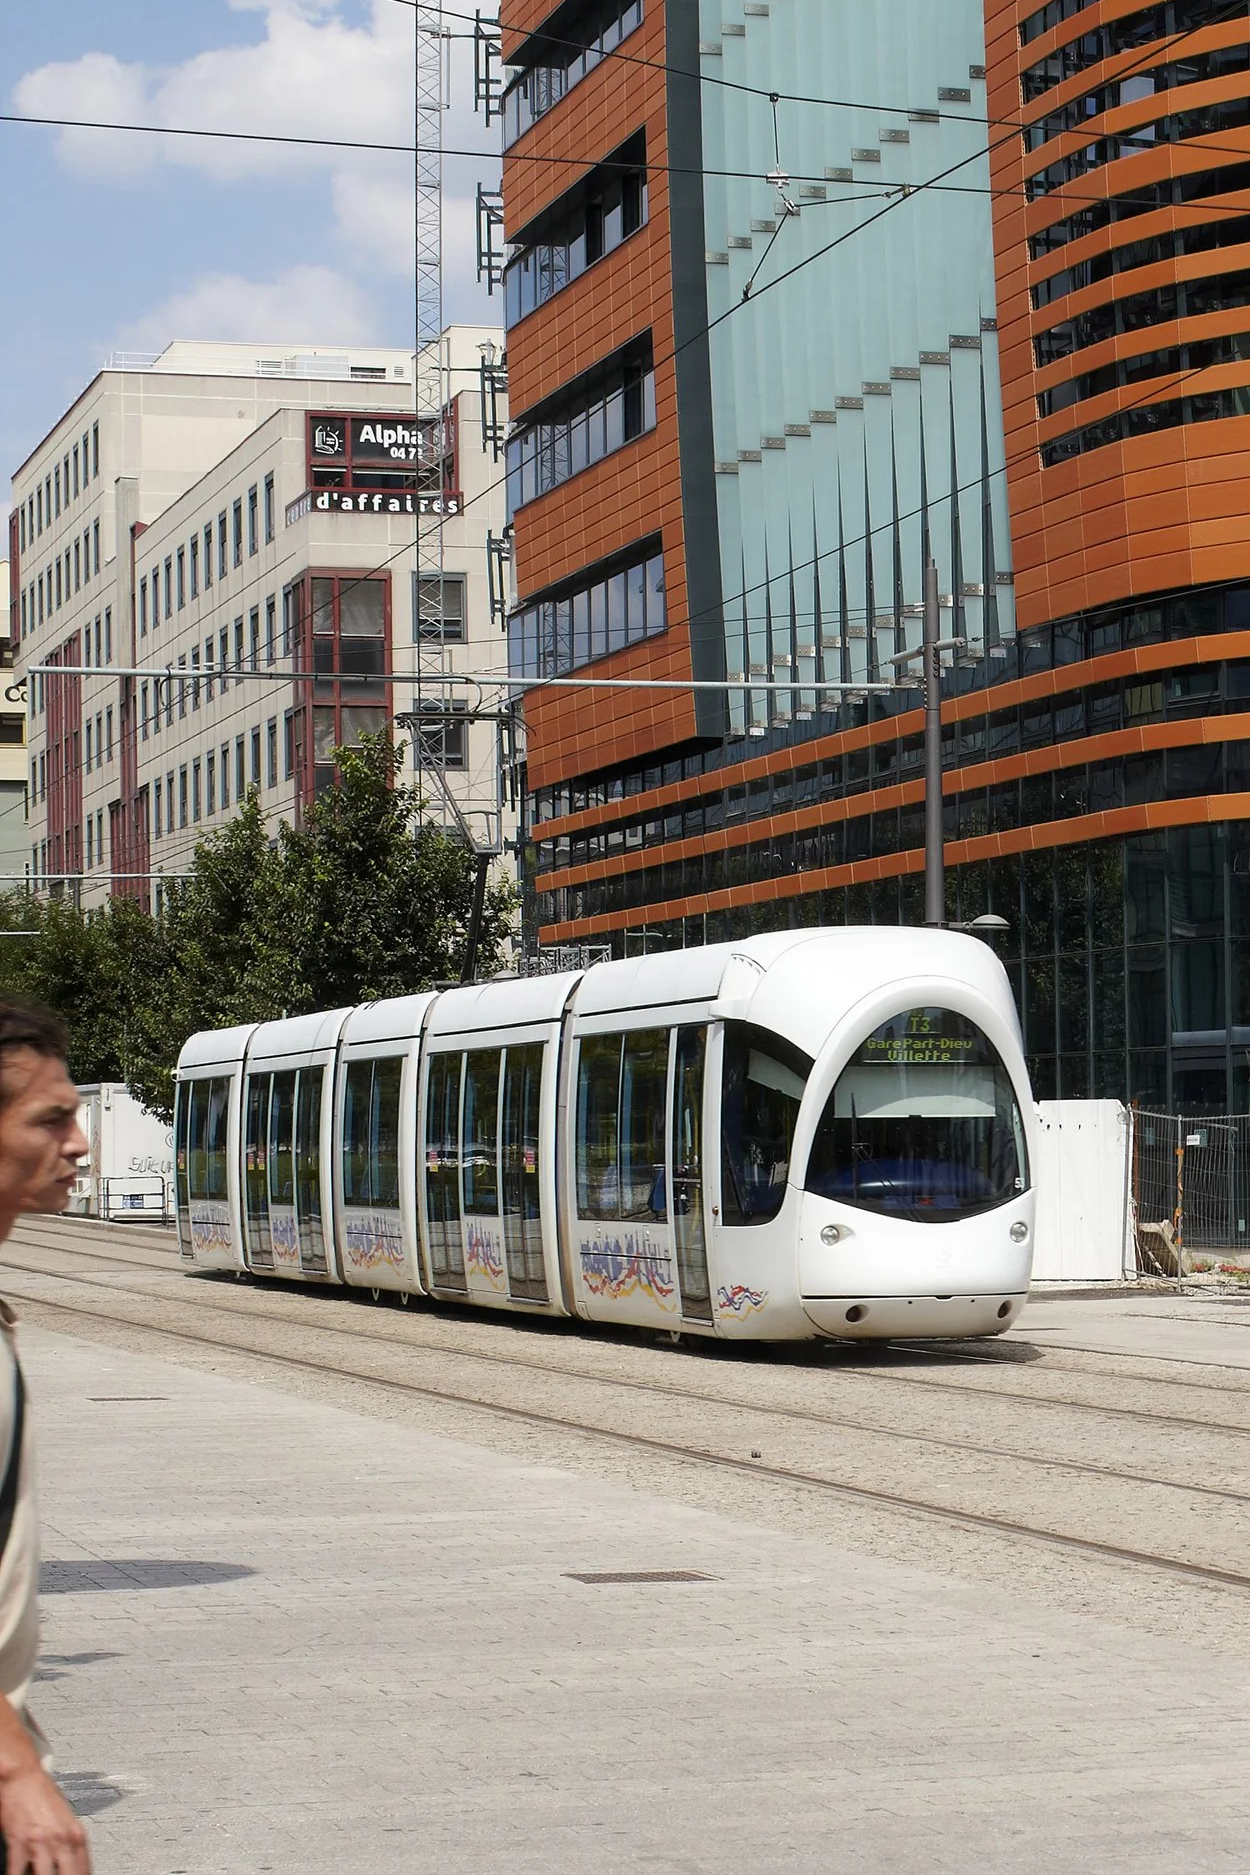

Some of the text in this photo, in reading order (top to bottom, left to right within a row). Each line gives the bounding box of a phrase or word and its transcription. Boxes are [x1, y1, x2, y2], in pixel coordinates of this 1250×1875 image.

[360, 424, 423, 448] Alpha
[390, 447, 406, 460] 04
[316, 491, 459, 514] d'affaires
[911, 1017, 930, 1032] T3
[866, 1037, 973, 1049] Gare Part-Dieu
[887, 1050, 951, 1061] Villette
